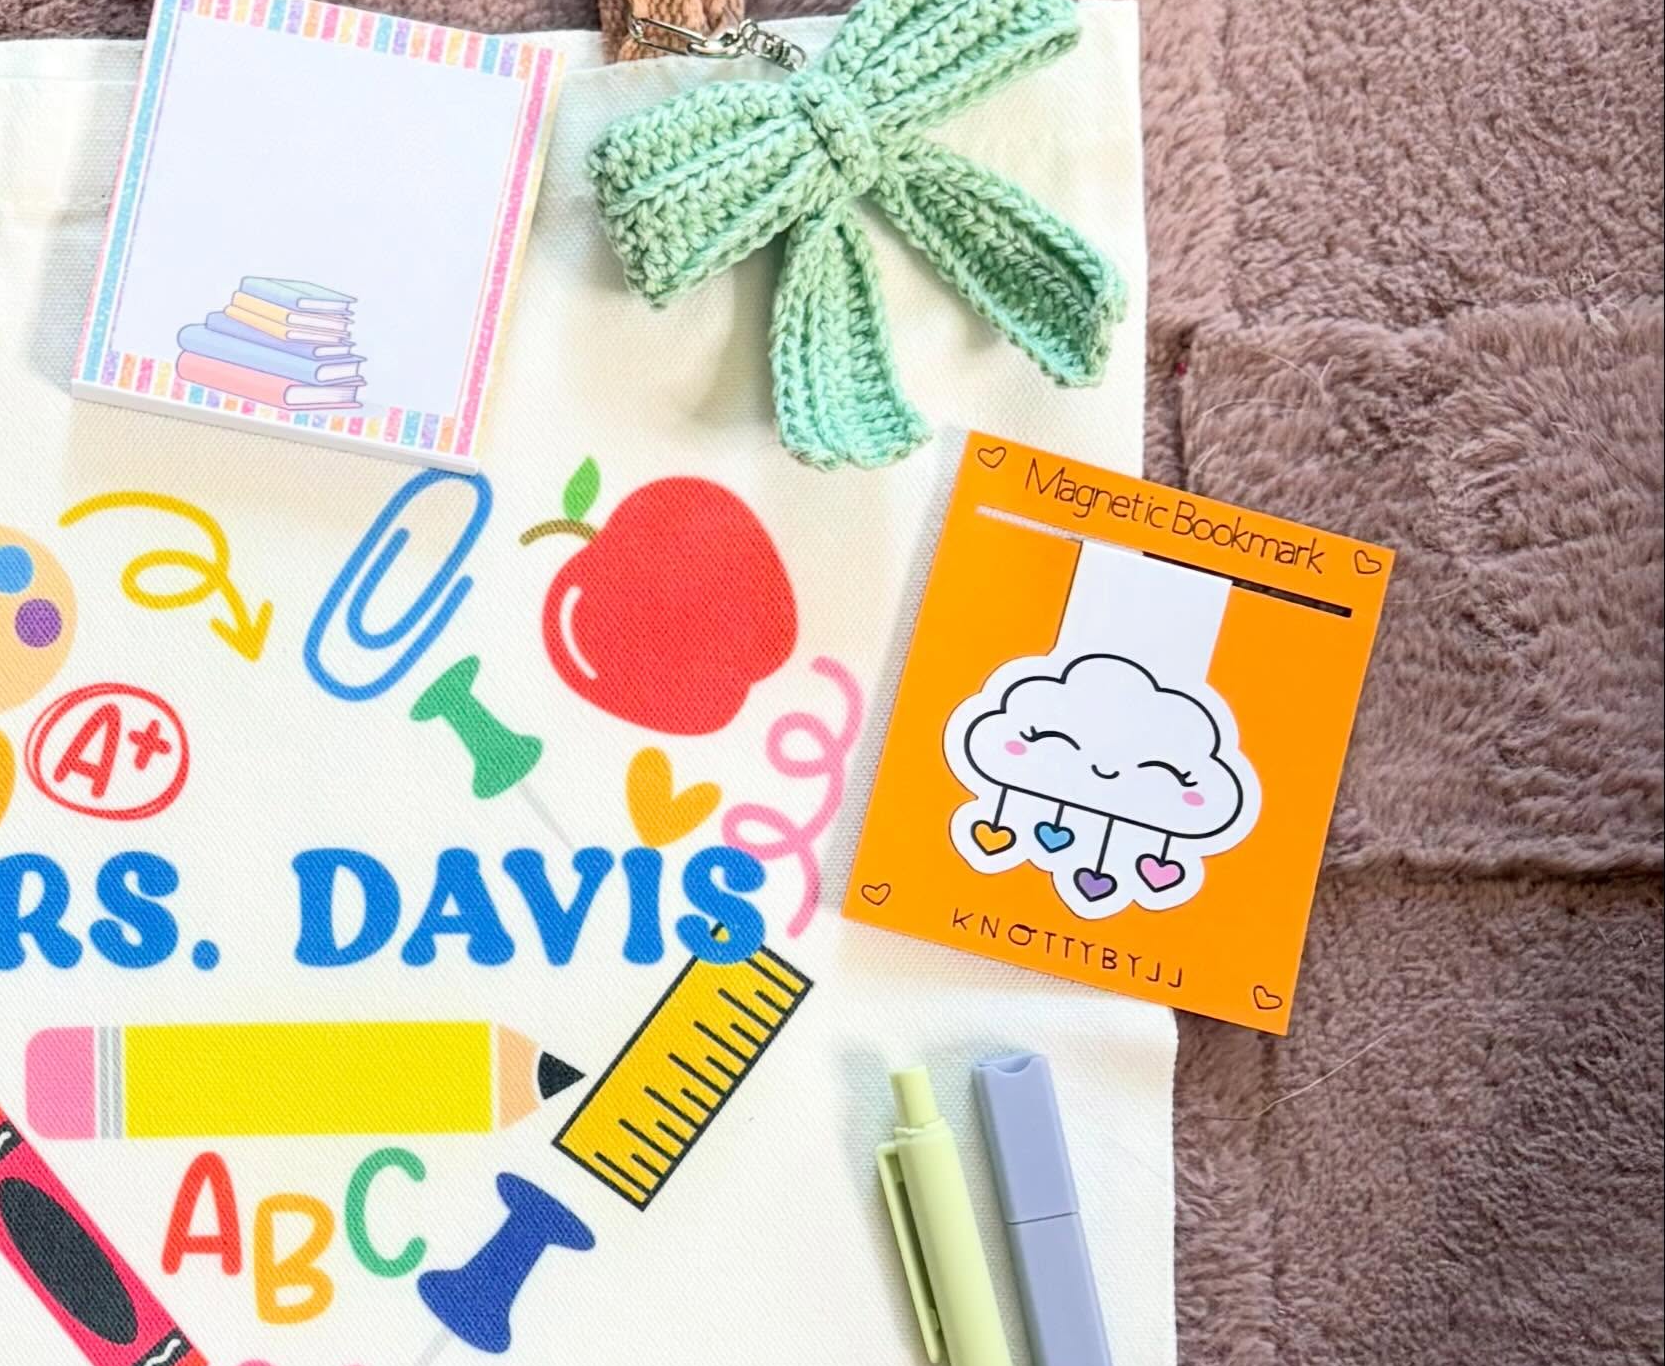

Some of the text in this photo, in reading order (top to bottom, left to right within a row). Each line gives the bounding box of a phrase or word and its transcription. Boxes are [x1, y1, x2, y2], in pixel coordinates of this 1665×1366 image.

[1024, 457, 1326, 575] Magnetic Bookmark
[54, 703, 172, 799] A+
[292, 844, 768, 970] DAVIS
[160, 1146, 429, 1326] ABC
